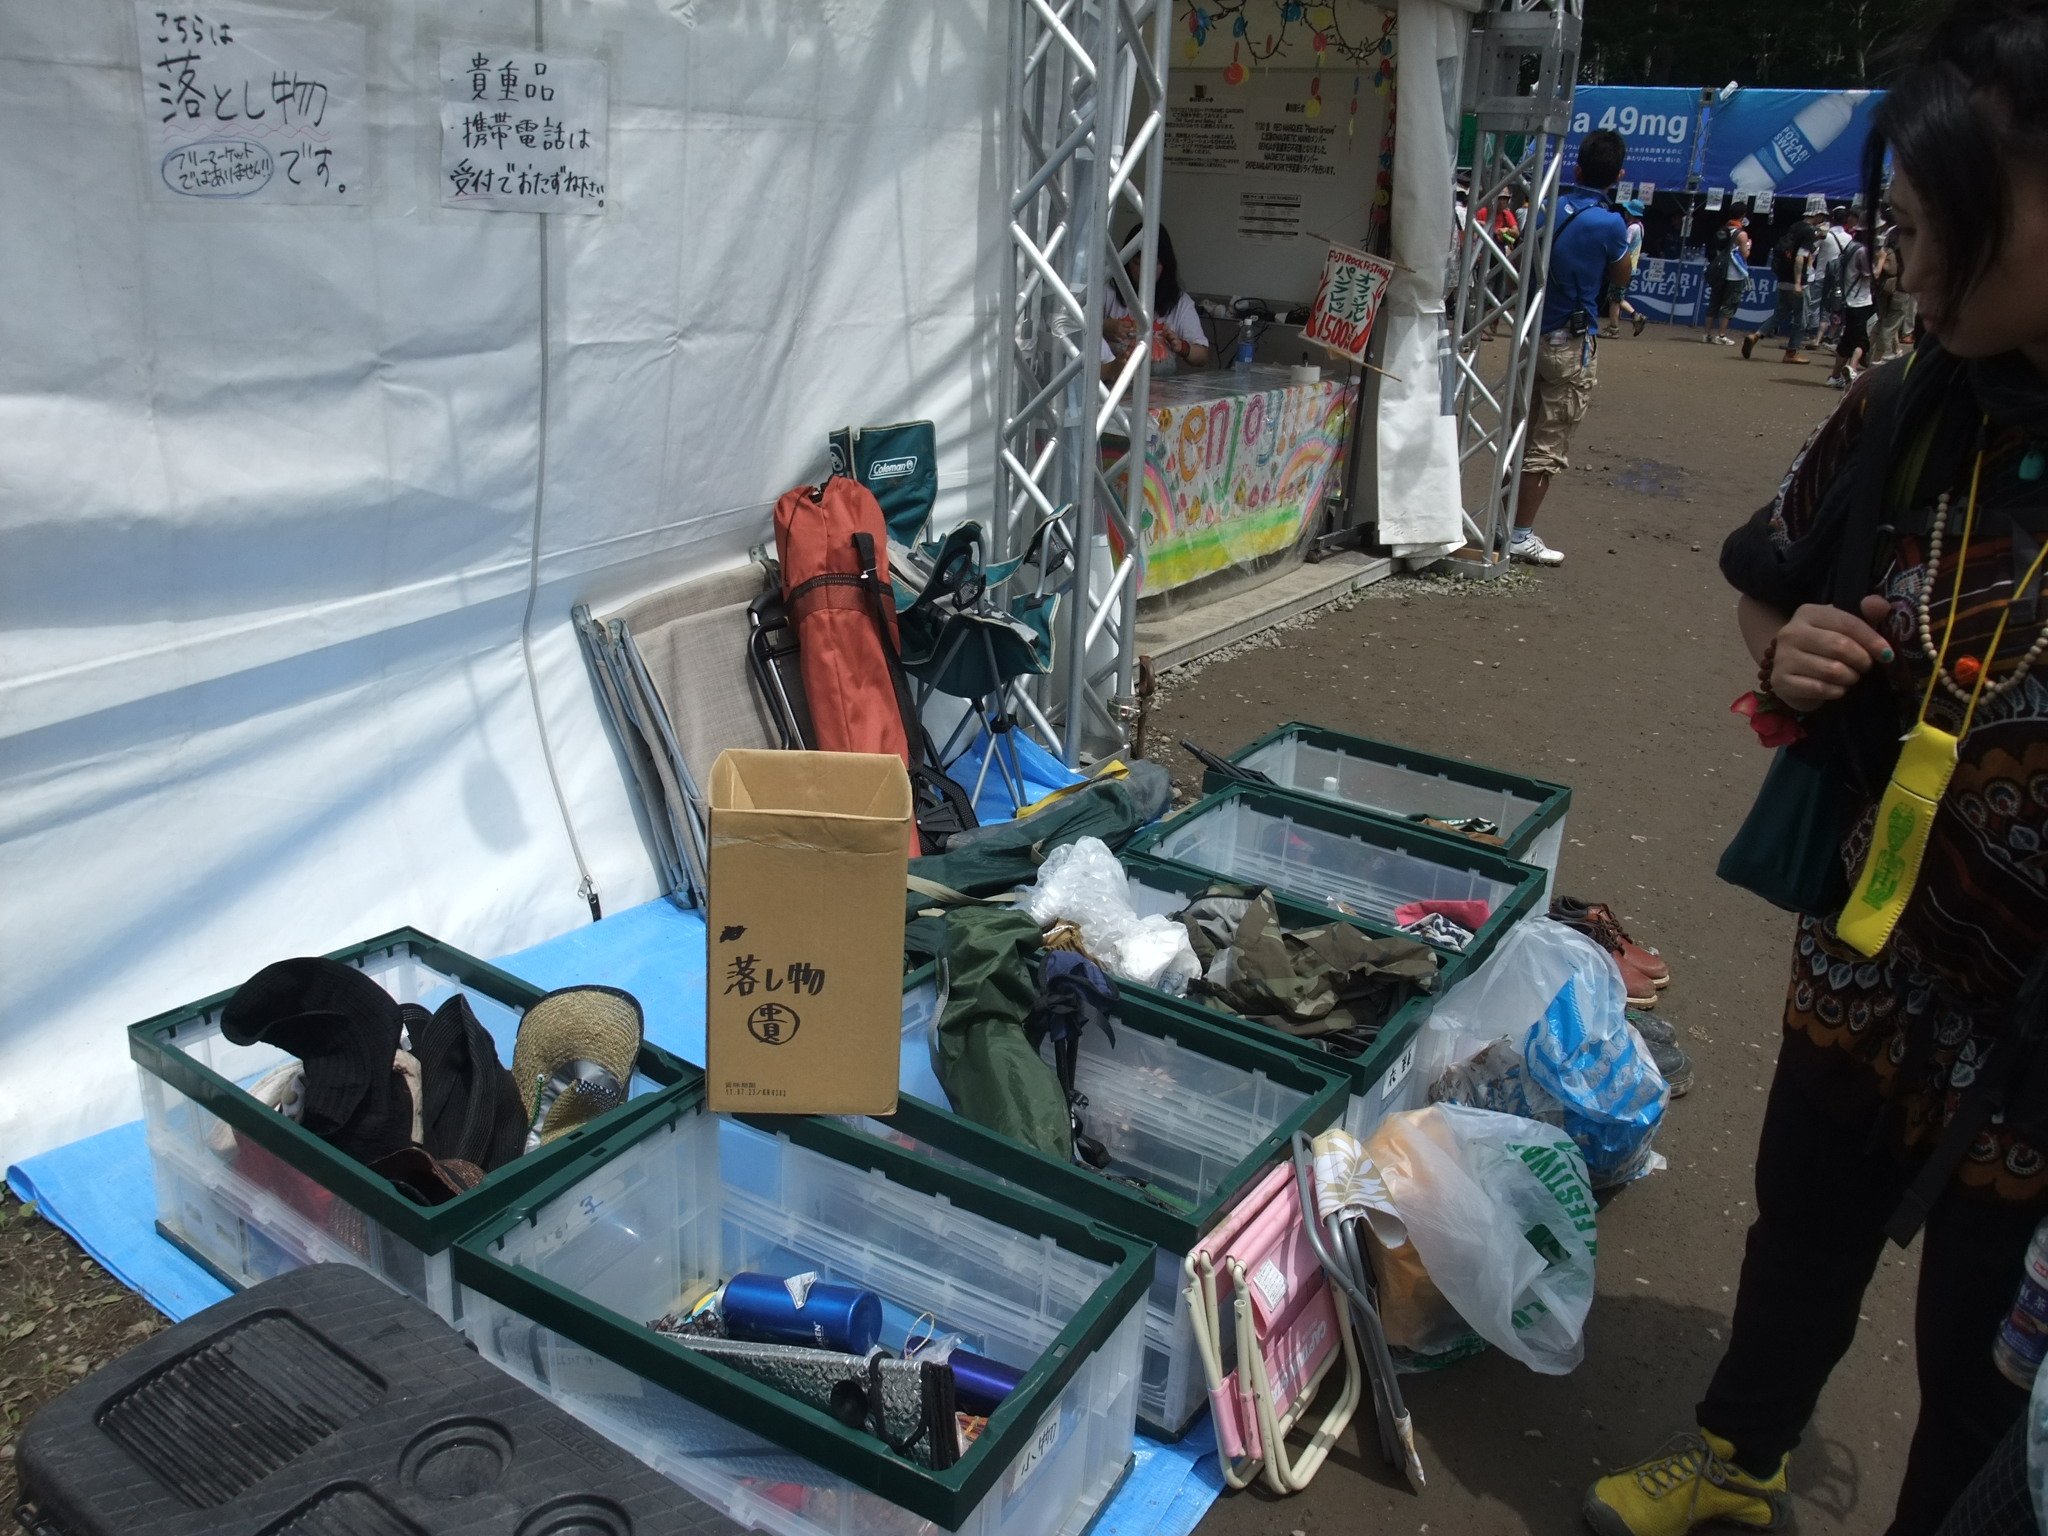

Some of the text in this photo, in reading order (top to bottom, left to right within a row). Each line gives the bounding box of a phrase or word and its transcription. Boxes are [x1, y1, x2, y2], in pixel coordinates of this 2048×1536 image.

[155, 12, 234, 46] こちらは
[156, 49, 328, 128] 落とし物
[465, 51, 555, 102] 貴重品
[462, 111, 591, 151] 携帯電話は
[1597, 106, 1688, 144] 49mg
[1781, 126, 1811, 162] POCARI
[279, 141, 346, 193] です。
[1773, 132, 1801, 165] SWEAT
[1327, 250, 1391, 281] FUJI ROCK FESTIVAL
[1631, 268, 1699, 288] POARI
[1328, 266, 1356, 313] パンフレット
[1628, 279, 1691, 299] SWEAT
[1317, 312, 1350, 349] 1500
[873, 460, 906, 476] Coleman
[723, 953, 826, 997] 落し物
[1504, 1142, 1598, 1233] FESTIVA
[1020, 1421, 1058, 1477] 小物
